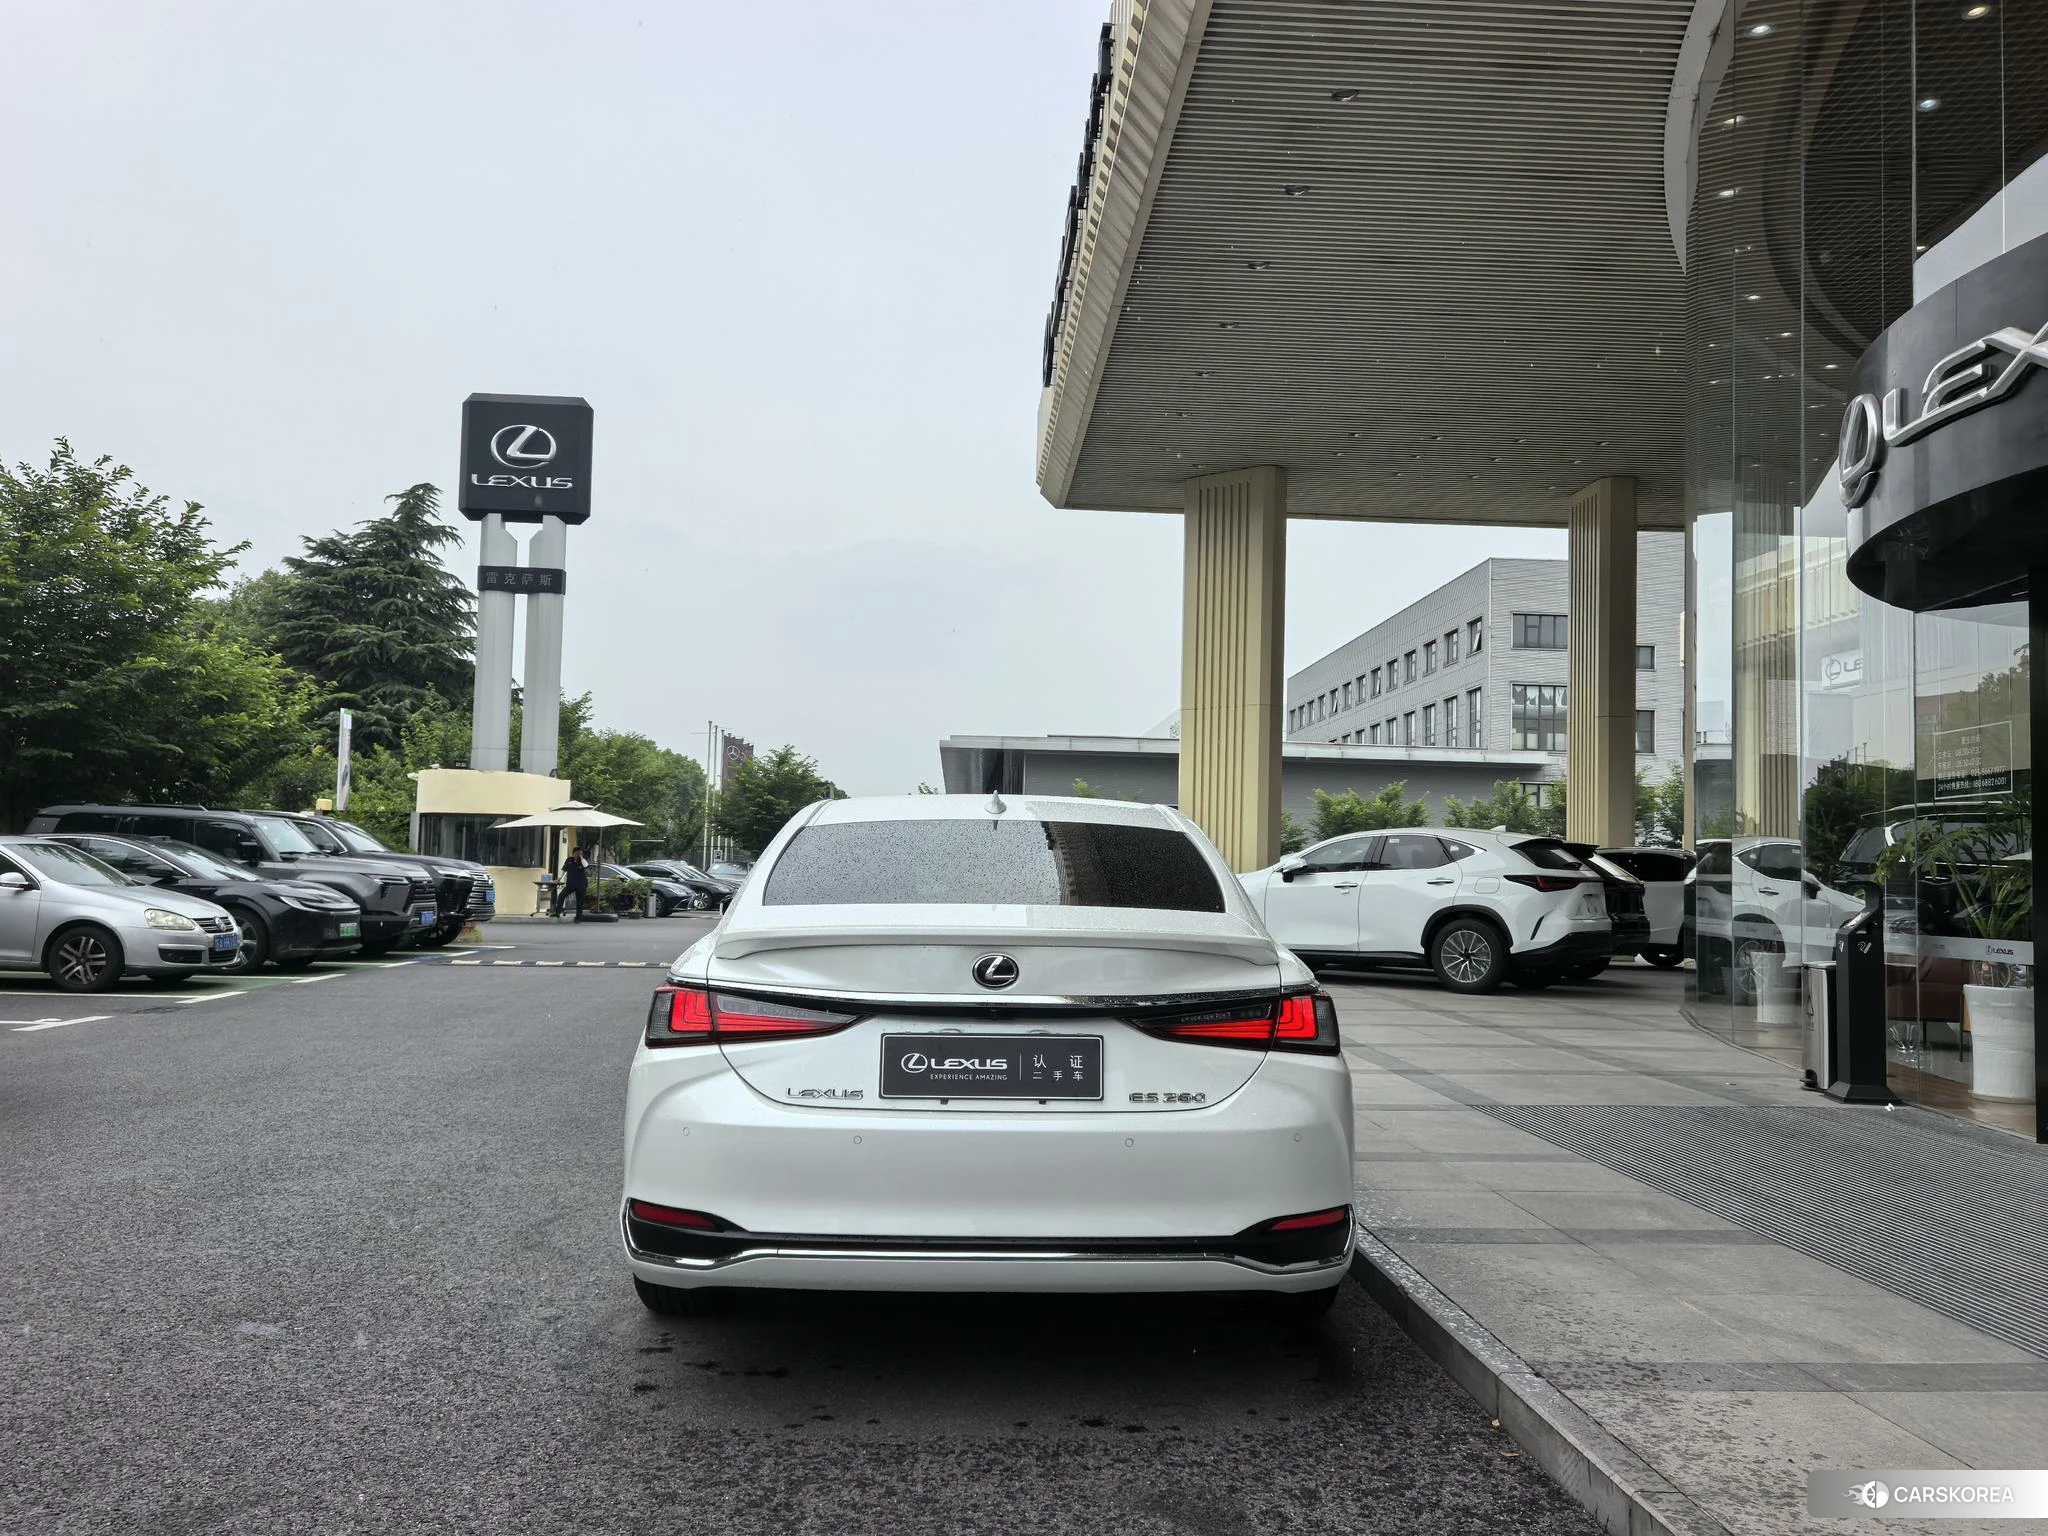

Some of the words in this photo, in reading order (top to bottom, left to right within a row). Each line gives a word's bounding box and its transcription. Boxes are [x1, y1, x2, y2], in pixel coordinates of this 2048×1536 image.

[471, 474, 573, 489] LEXUS
[486, 572, 553, 586] 雷克萨斯
[930, 1057, 1008, 1070] LEXUS
[930, 1073, 973, 1081] EXPERIENCE
[786, 1087, 864, 1100] LEXUS
[1128, 1092, 1159, 1103] ES
[1162, 1092, 1206, 1103] 260
